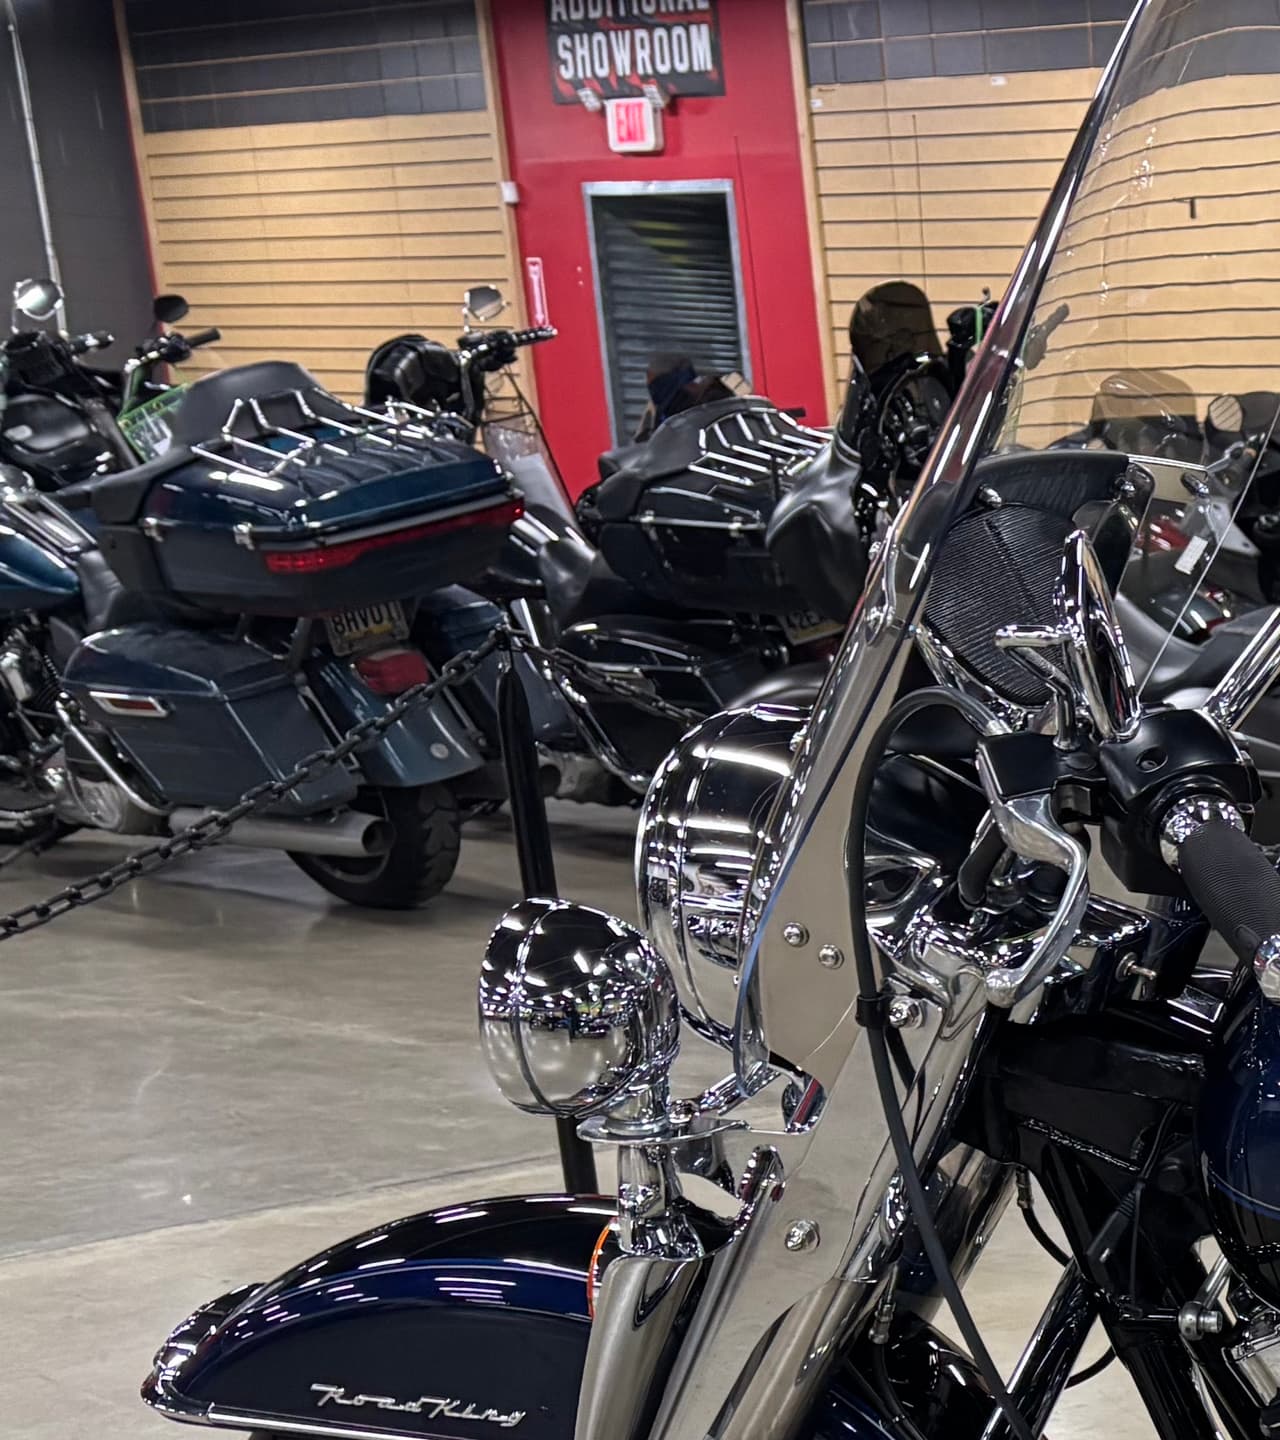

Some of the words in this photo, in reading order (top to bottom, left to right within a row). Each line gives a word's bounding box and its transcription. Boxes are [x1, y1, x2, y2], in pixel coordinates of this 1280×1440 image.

[552, 0, 709, 22] ADDIT
[557, 24, 713, 79] SHOWROOM
[615, 102, 646, 143] EXIT
